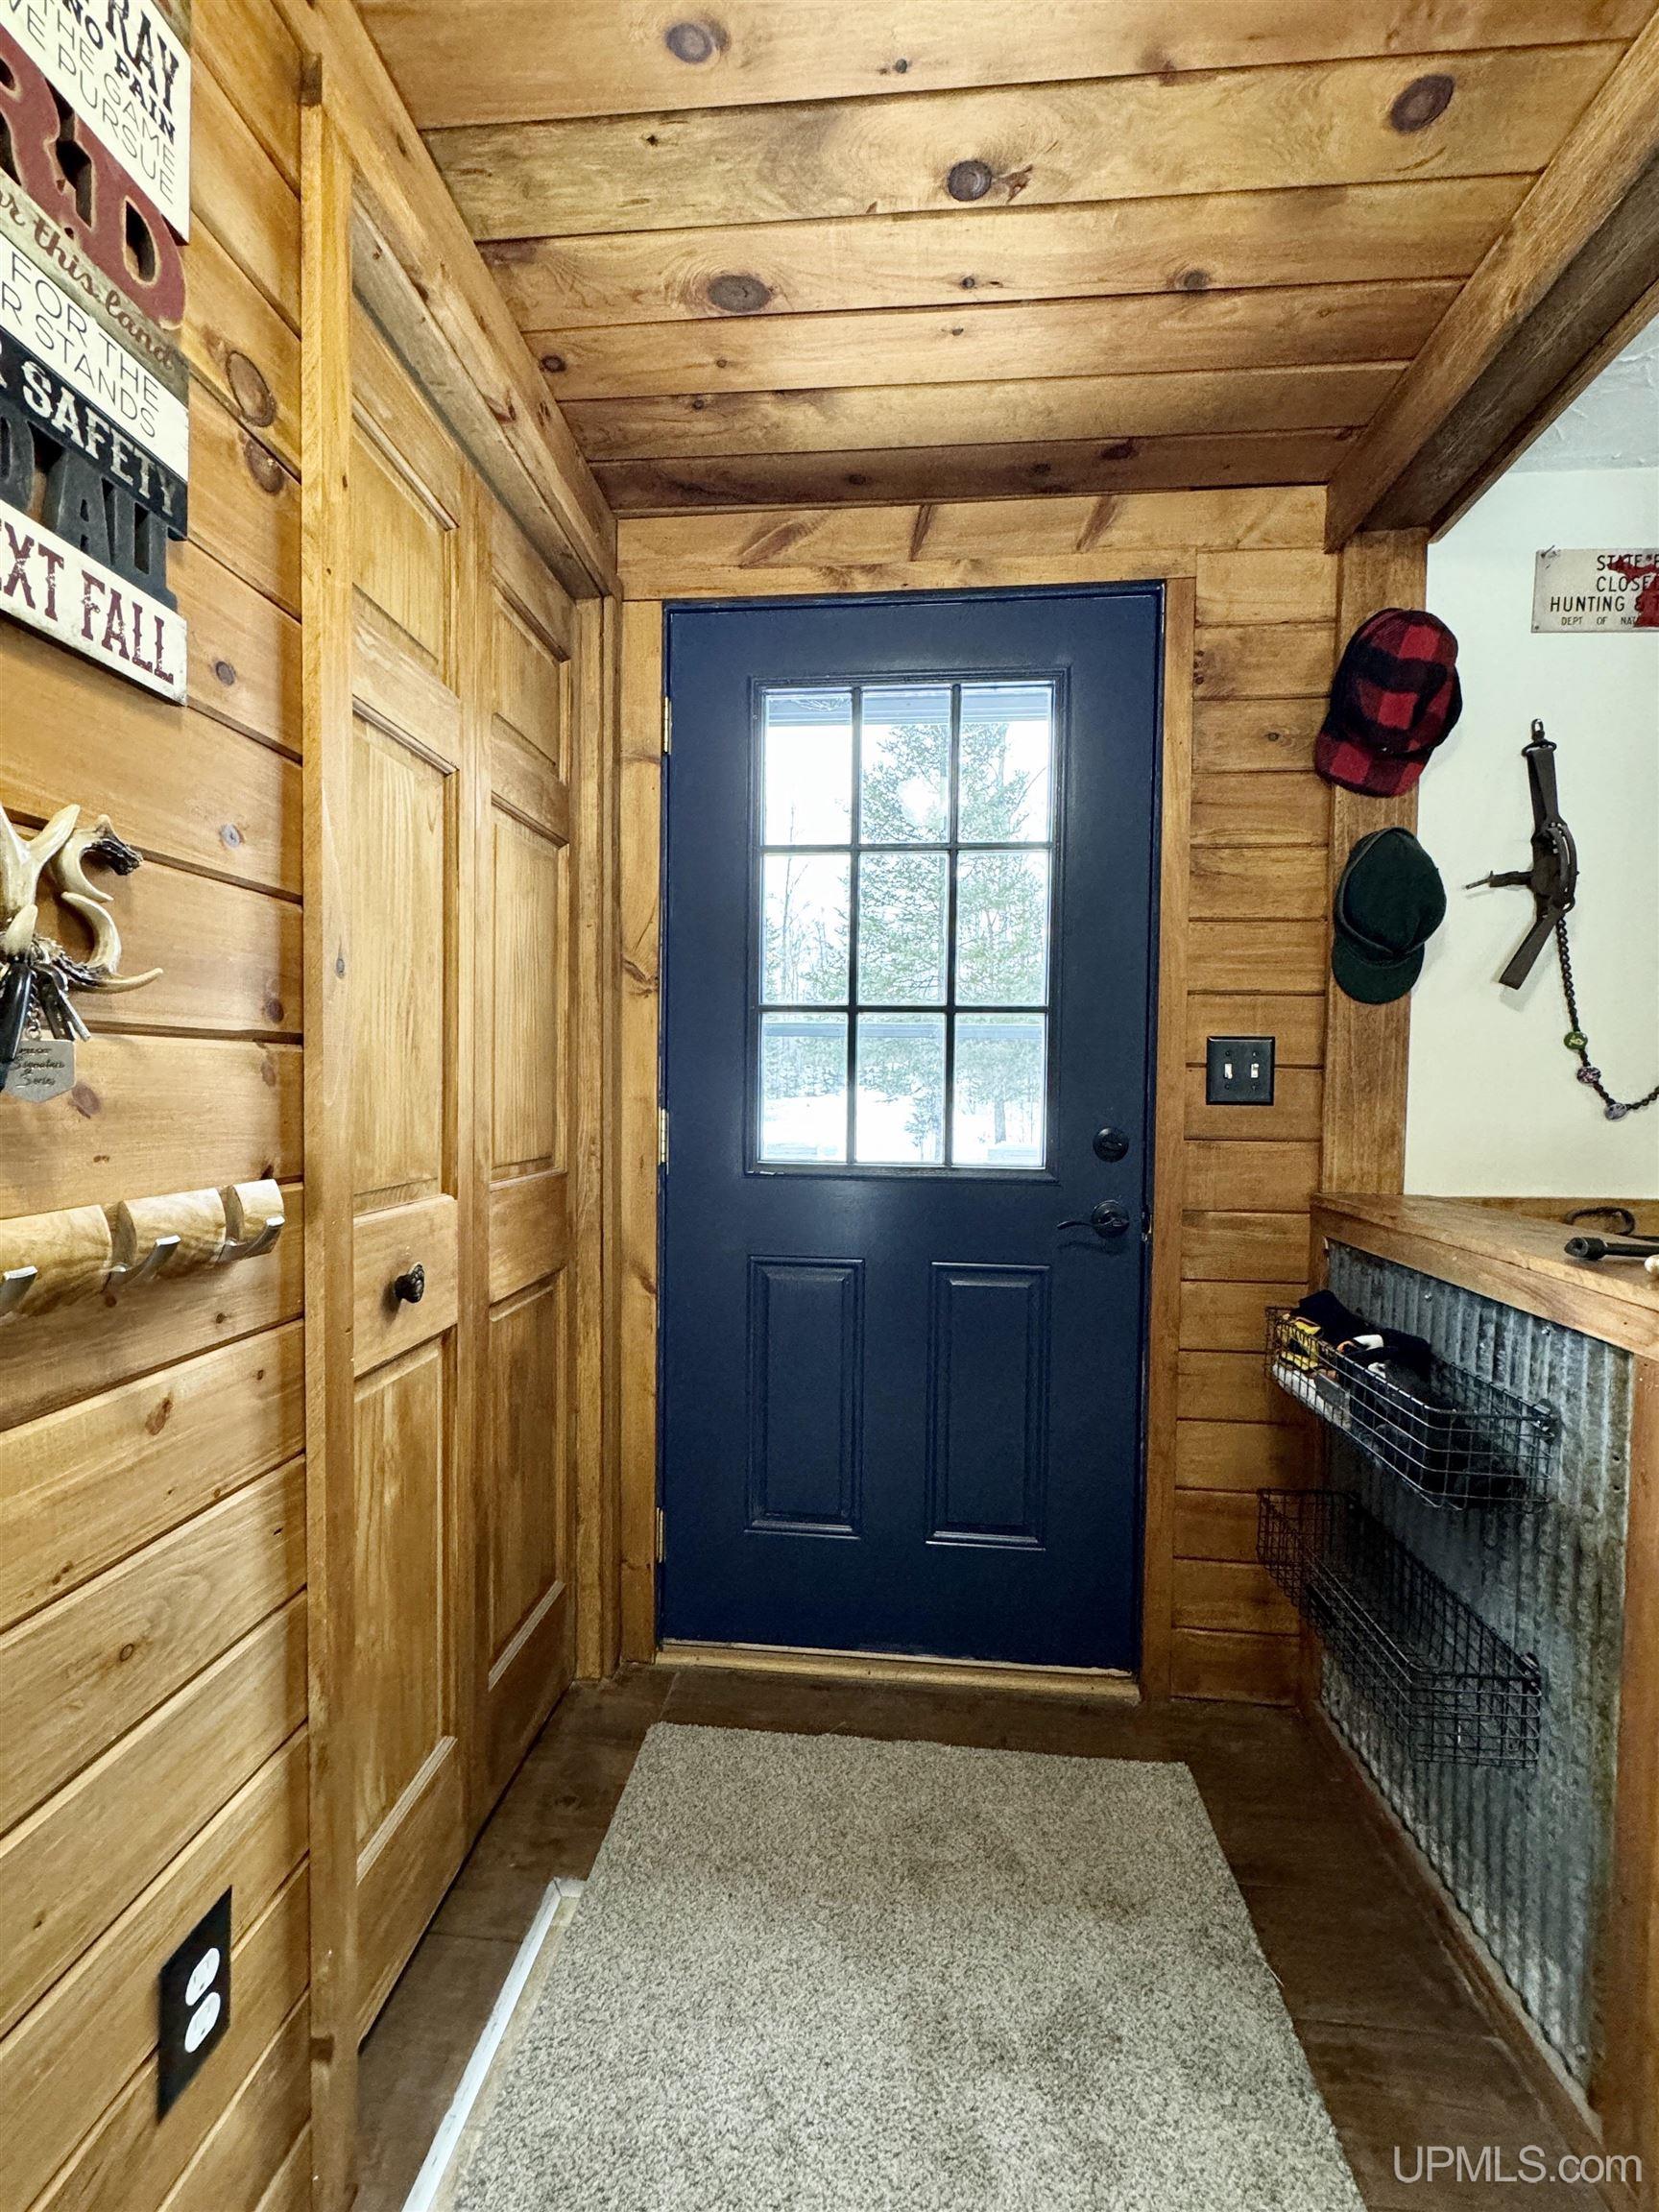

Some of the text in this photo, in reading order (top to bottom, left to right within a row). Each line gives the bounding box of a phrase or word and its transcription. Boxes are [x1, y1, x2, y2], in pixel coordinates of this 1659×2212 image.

[85, 0, 179, 114] RAY
[114, 49, 176, 146] PAIN
[59, 43, 174, 204] PURSUE
[104, 73, 175, 176] GAME
[12, 252, 87, 347] FOR
[99, 332, 158, 412] THE
[34, 212, 99, 299] this
[106, 290, 176, 370] land
[36, 314, 156, 438] STANDS
[21, 361, 177, 517] SAFETY
[82, 569, 174, 685] FALL
[1551, 596, 1624, 612] HUNTING
[1561, 616, 1583, 625] DEPT
[1597, 616, 1608, 625] OF
[1597, 576, 1659, 591] CLOSE
